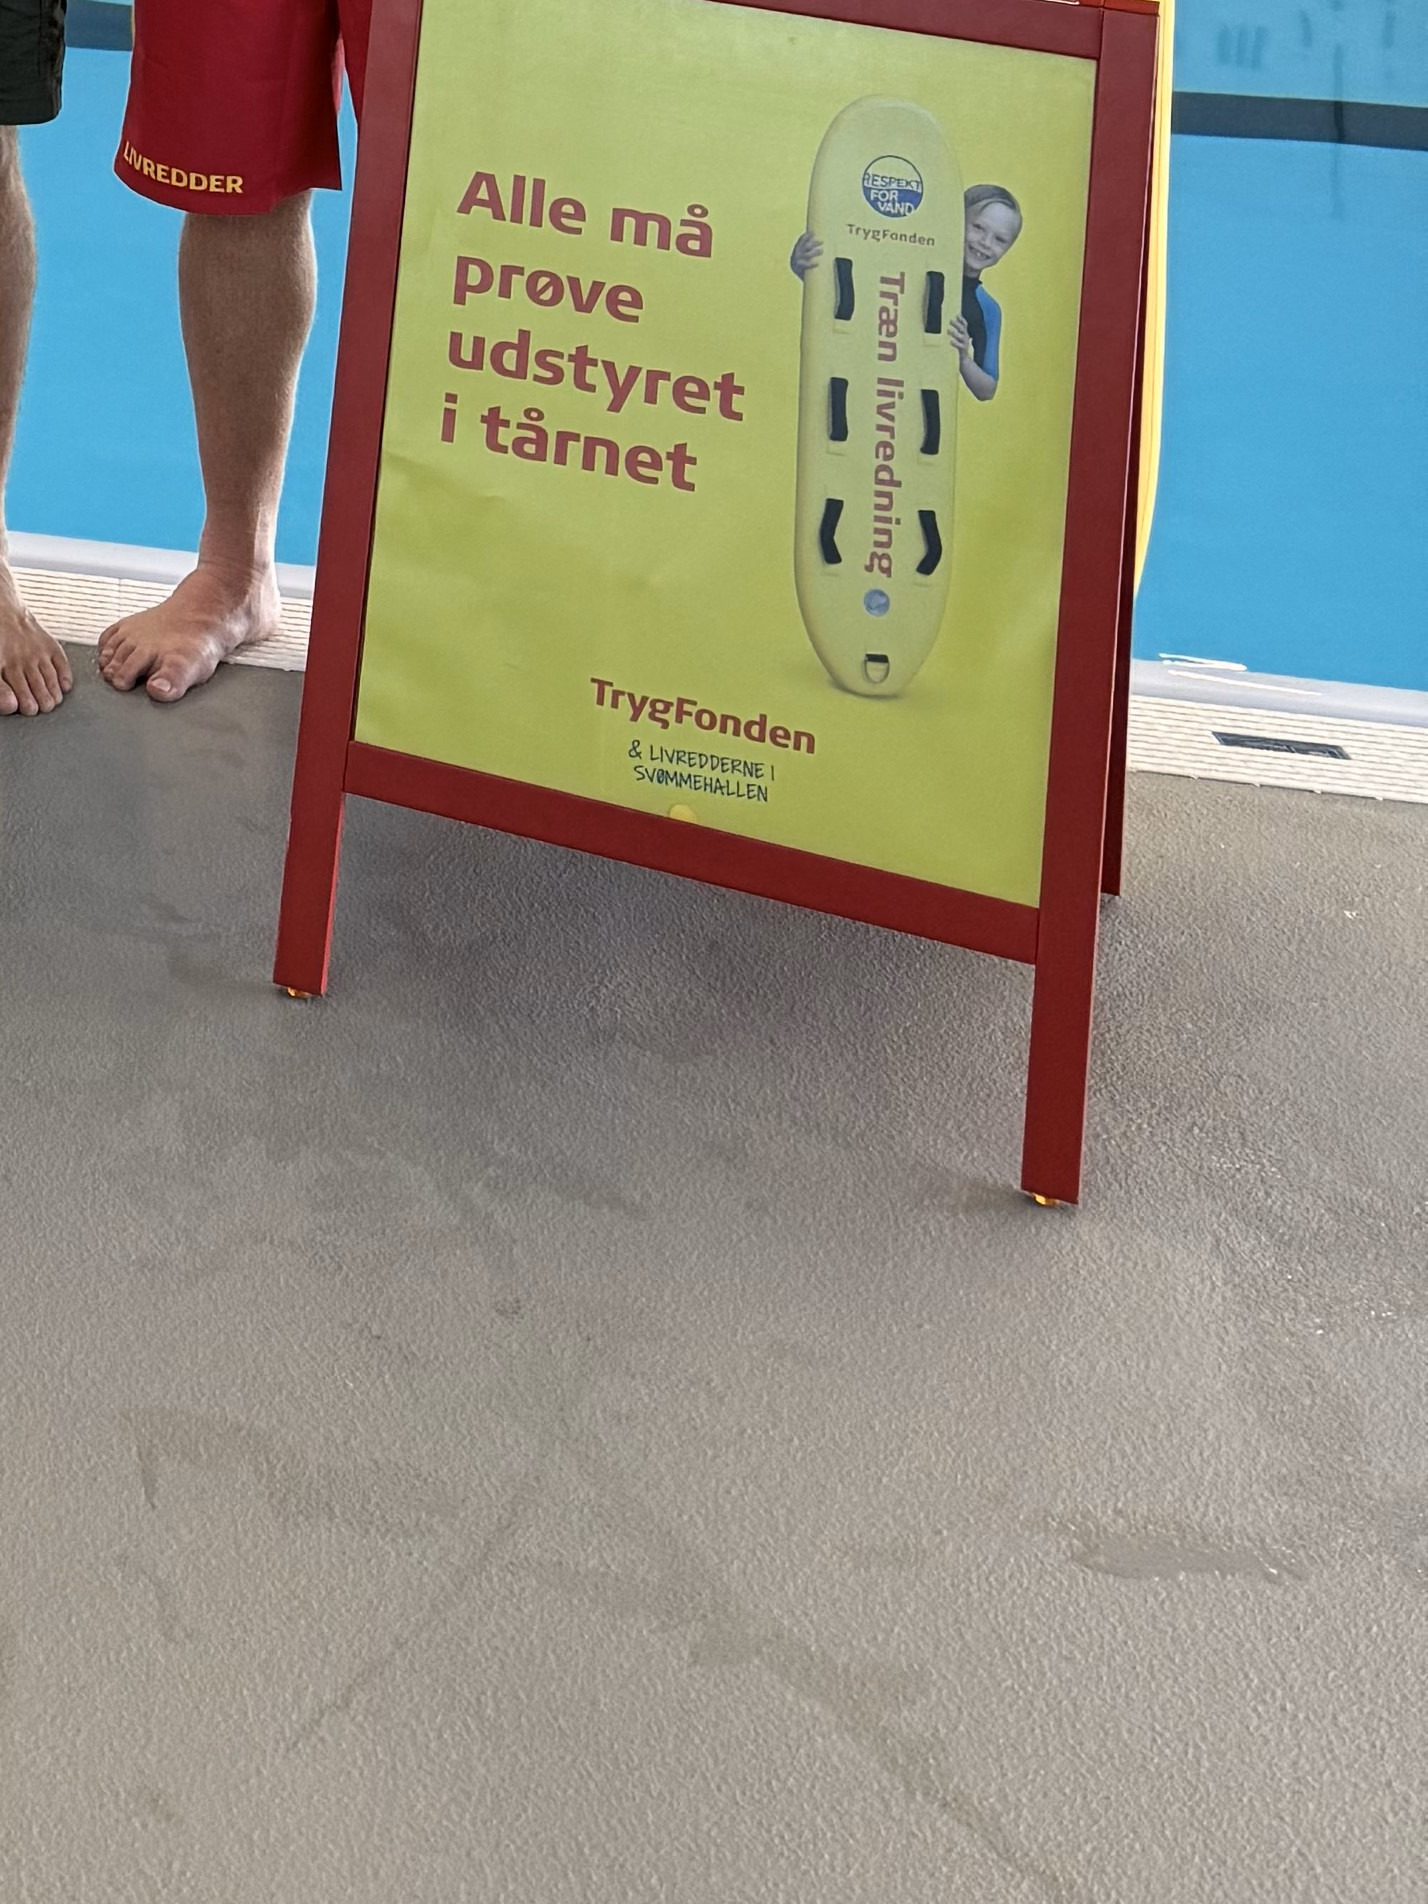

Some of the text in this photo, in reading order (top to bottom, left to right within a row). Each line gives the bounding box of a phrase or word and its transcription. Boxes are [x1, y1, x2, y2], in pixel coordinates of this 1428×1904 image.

[122, 141, 244, 193] LIVREDDER
[863, 172, 921, 190] RESPEKT
[456, 170, 714, 260] Alle må
[870, 190, 899, 202] FOR
[877, 202, 915, 216] VAND
[846, 223, 936, 247] TrygFonden
[452, 255, 644, 325] prøve
[447, 330, 746, 424] udstyret
[440, 394, 698, 493] i tårnet
[863, 271, 906, 579] Træn livredning
[590, 677, 816, 755] TrygFonden
[628, 739, 643, 760] &
[650, 744, 765, 780] LIVREDDERNE
[633, 765, 769, 803] SVØMMEHALLEN
